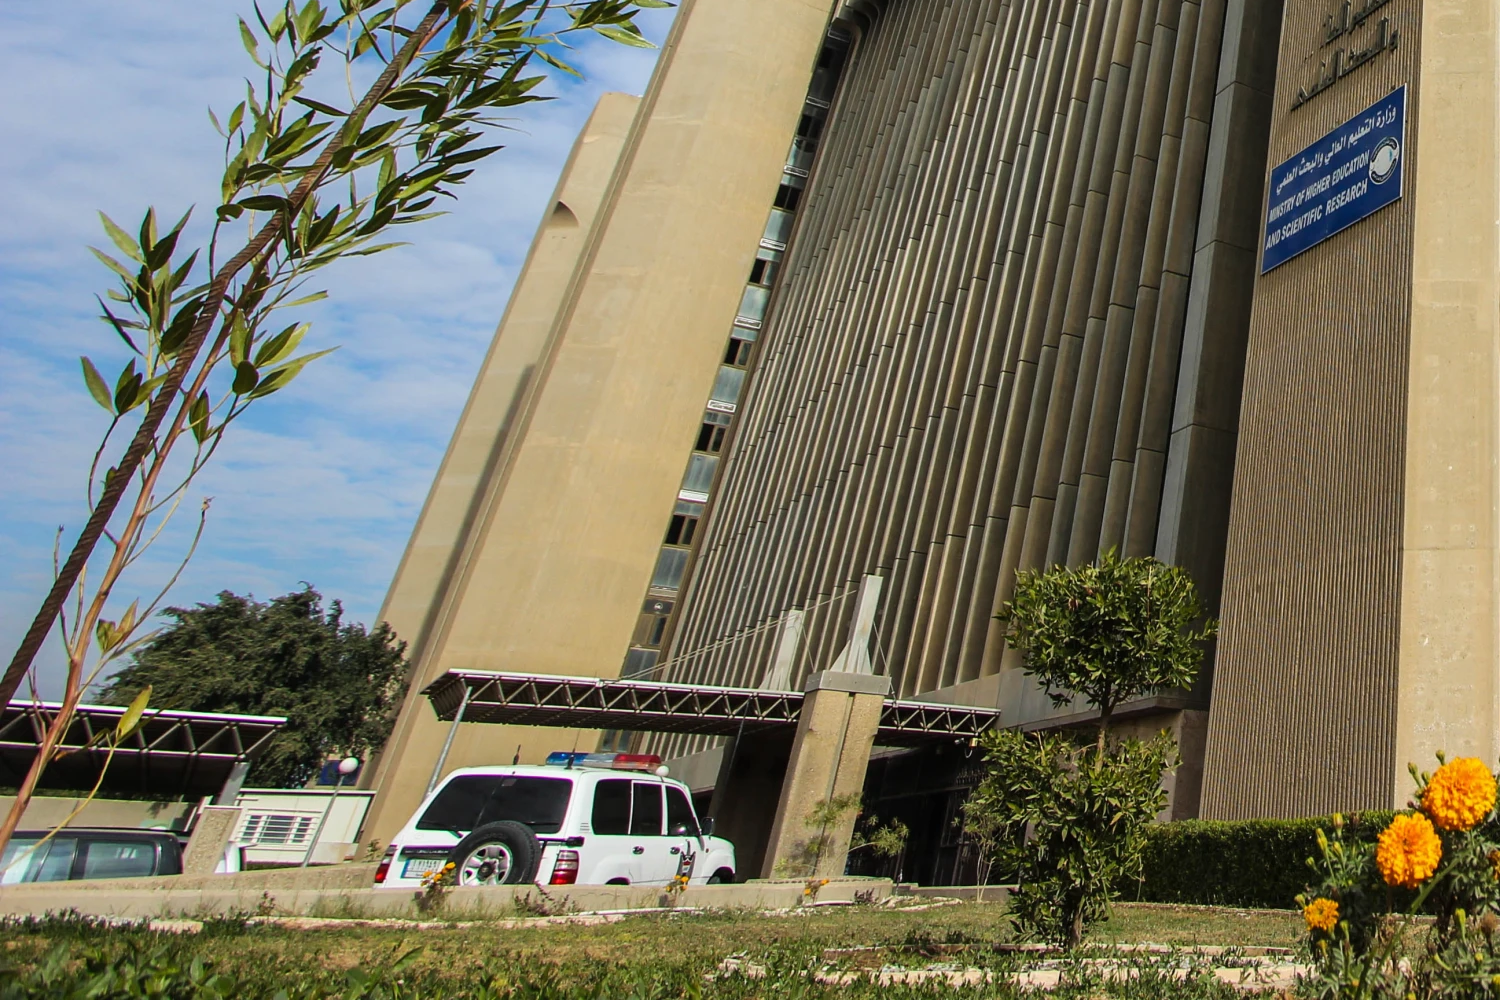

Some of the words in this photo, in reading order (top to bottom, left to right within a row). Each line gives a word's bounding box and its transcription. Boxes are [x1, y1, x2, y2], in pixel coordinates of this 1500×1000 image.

[1376, 104, 1397, 128] وزارة
[1347, 117, 1375, 149] التعليم
[1298, 149, 1324, 176] والبحث
[1324, 134, 1347, 165] العالي
[1276, 166, 1298, 196] العلمي
[1295, 190, 1306, 207] OF
[1304, 174, 1331, 202] HIGHER
[1331, 149, 1370, 186] EDUCATION
[1265, 229, 1281, 251] AND
[1281, 204, 1323, 241] SCIENTIFIC
[1325, 178, 1369, 216] RESEARCH
